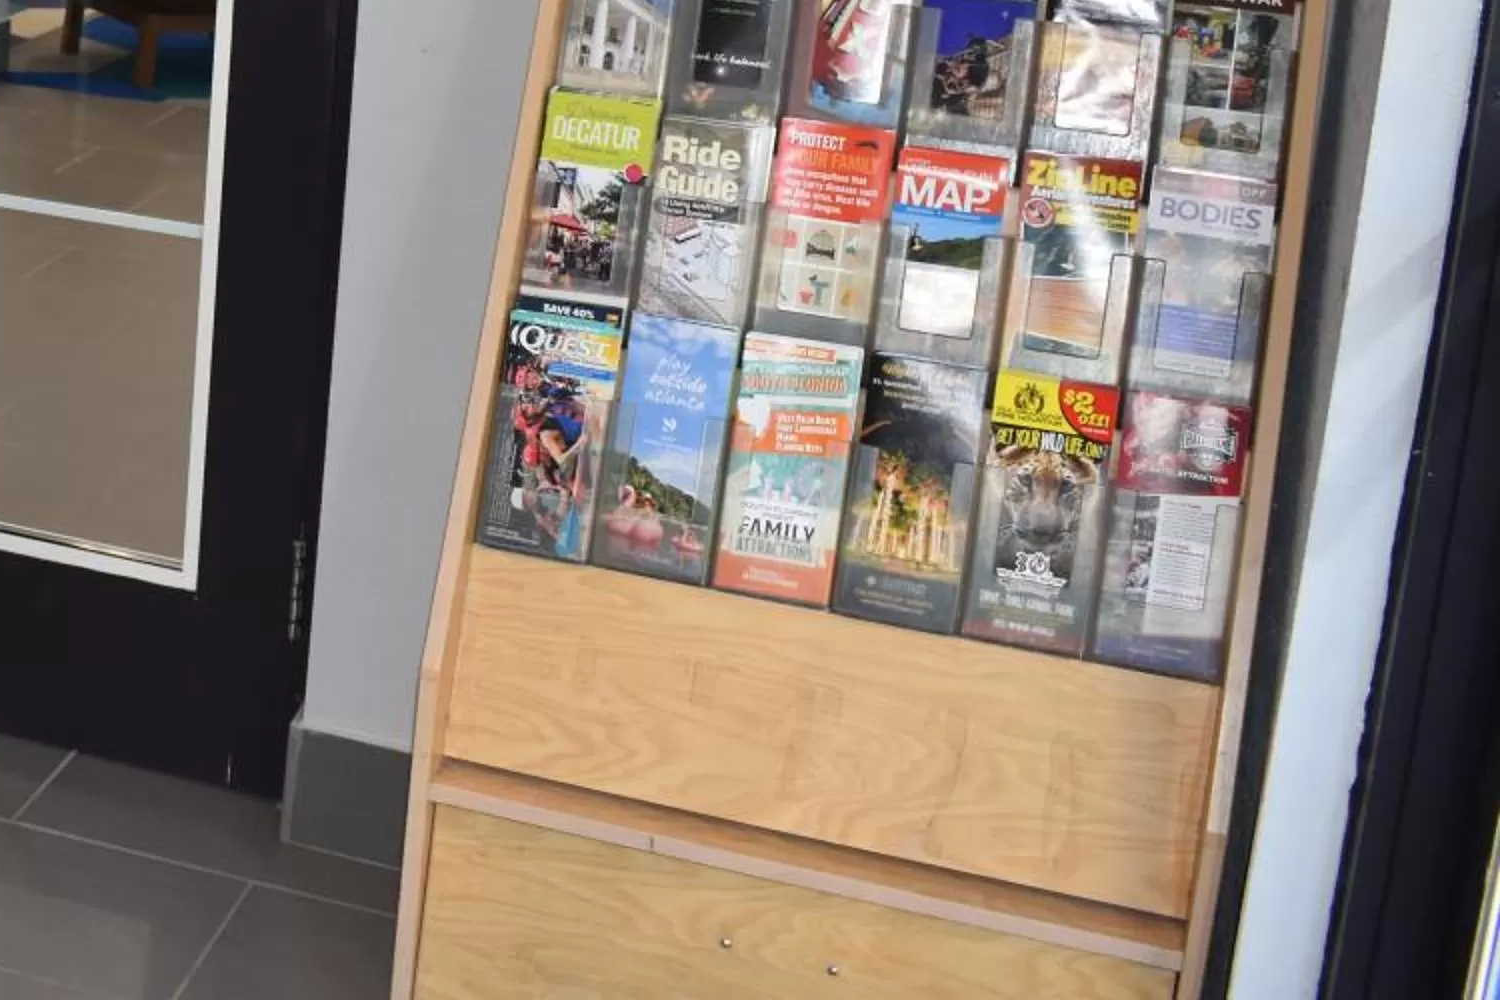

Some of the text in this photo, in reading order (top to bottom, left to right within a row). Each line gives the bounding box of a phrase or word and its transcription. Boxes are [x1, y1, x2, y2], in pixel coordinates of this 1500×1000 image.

[552, 115, 641, 150] DECATUR
[790, 131, 846, 151] PROTECT
[663, 134, 742, 171] Ride
[658, 165, 740, 203] Guide
[900, 174, 992, 212] MAP
[1160, 196, 1263, 230] BODIES
[543, 303, 570, 317] SAVE
[1063, 389, 1095, 414] $2
[996, 427, 1015, 445] GET
[1016, 428, 1041, 449] YOUR
[1041, 431, 1065, 453] WILD
[1065, 435, 1085, 457] LIFE
[738, 515, 816, 544] FAMILY
